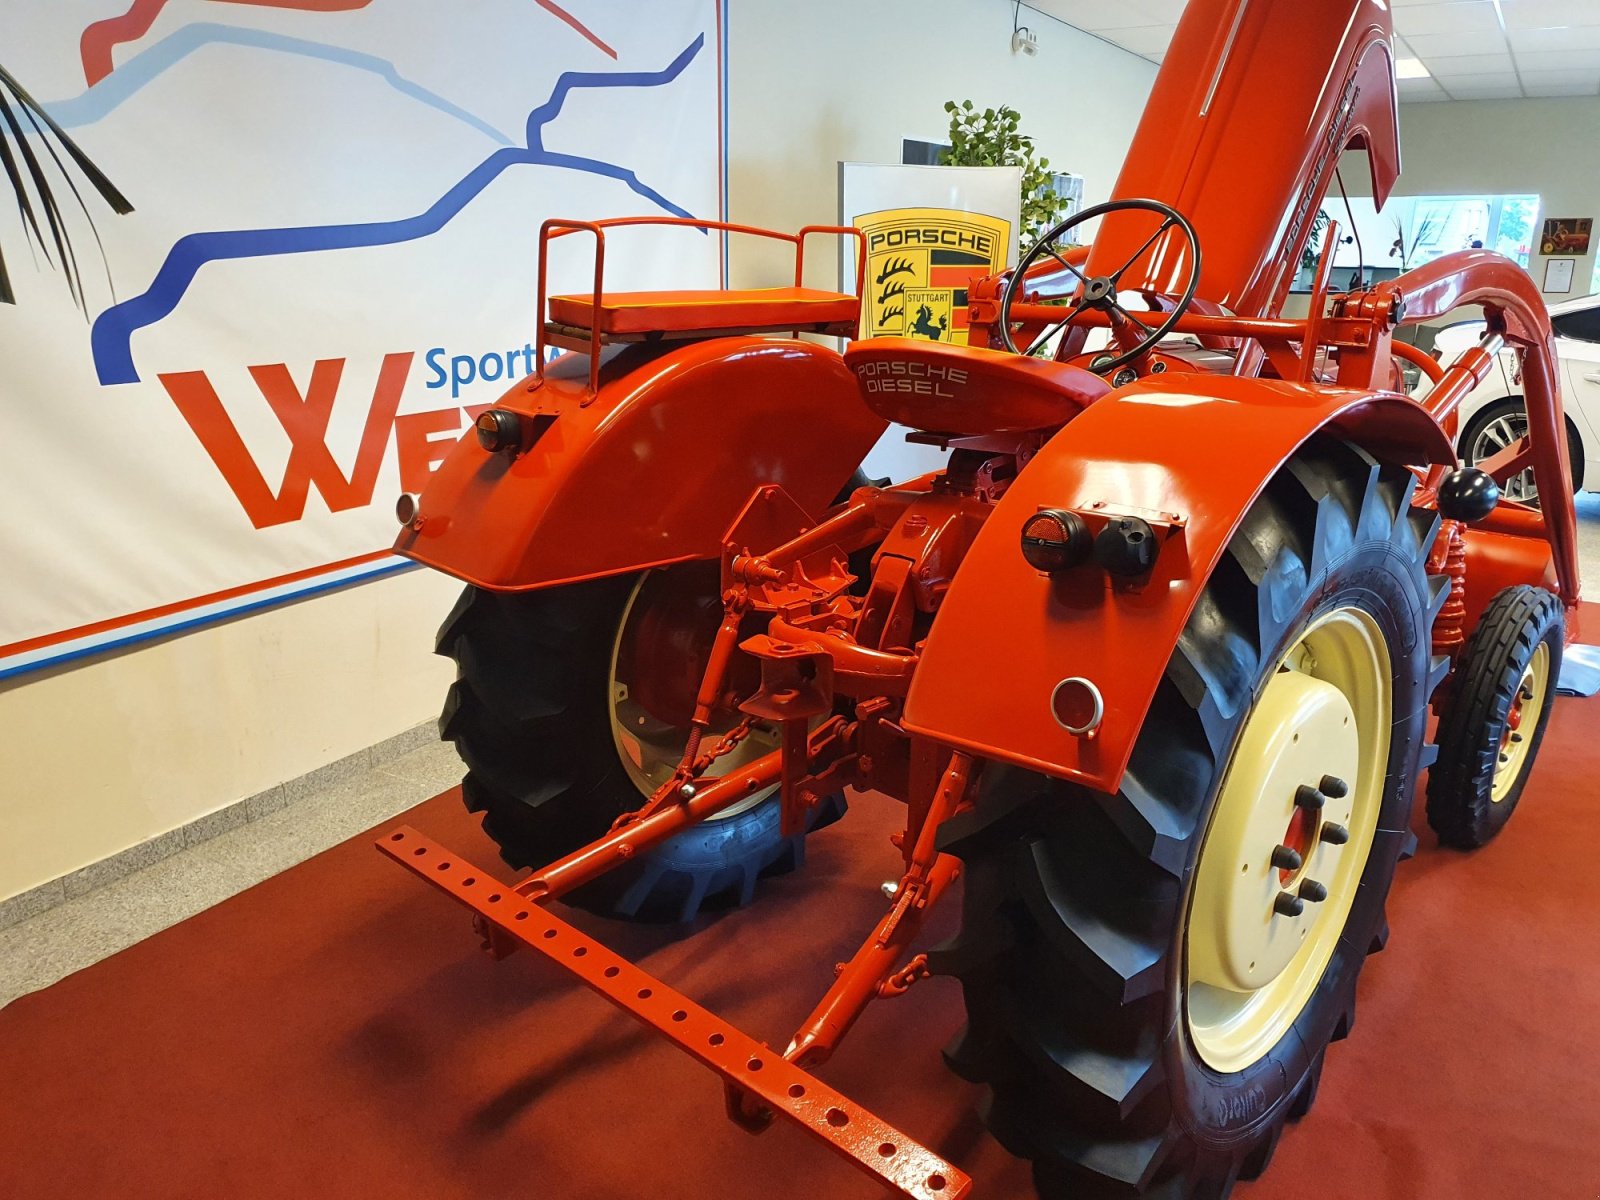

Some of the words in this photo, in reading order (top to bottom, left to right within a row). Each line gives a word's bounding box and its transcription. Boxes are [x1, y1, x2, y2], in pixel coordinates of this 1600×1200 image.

[870, 229, 991, 253] PORSCHE
[907, 293, 949, 303] STUTTGART
[858, 361, 968, 384] PORSCHE
[866, 379, 954, 398] DIESEL
[156, 351, 493, 530] WE
